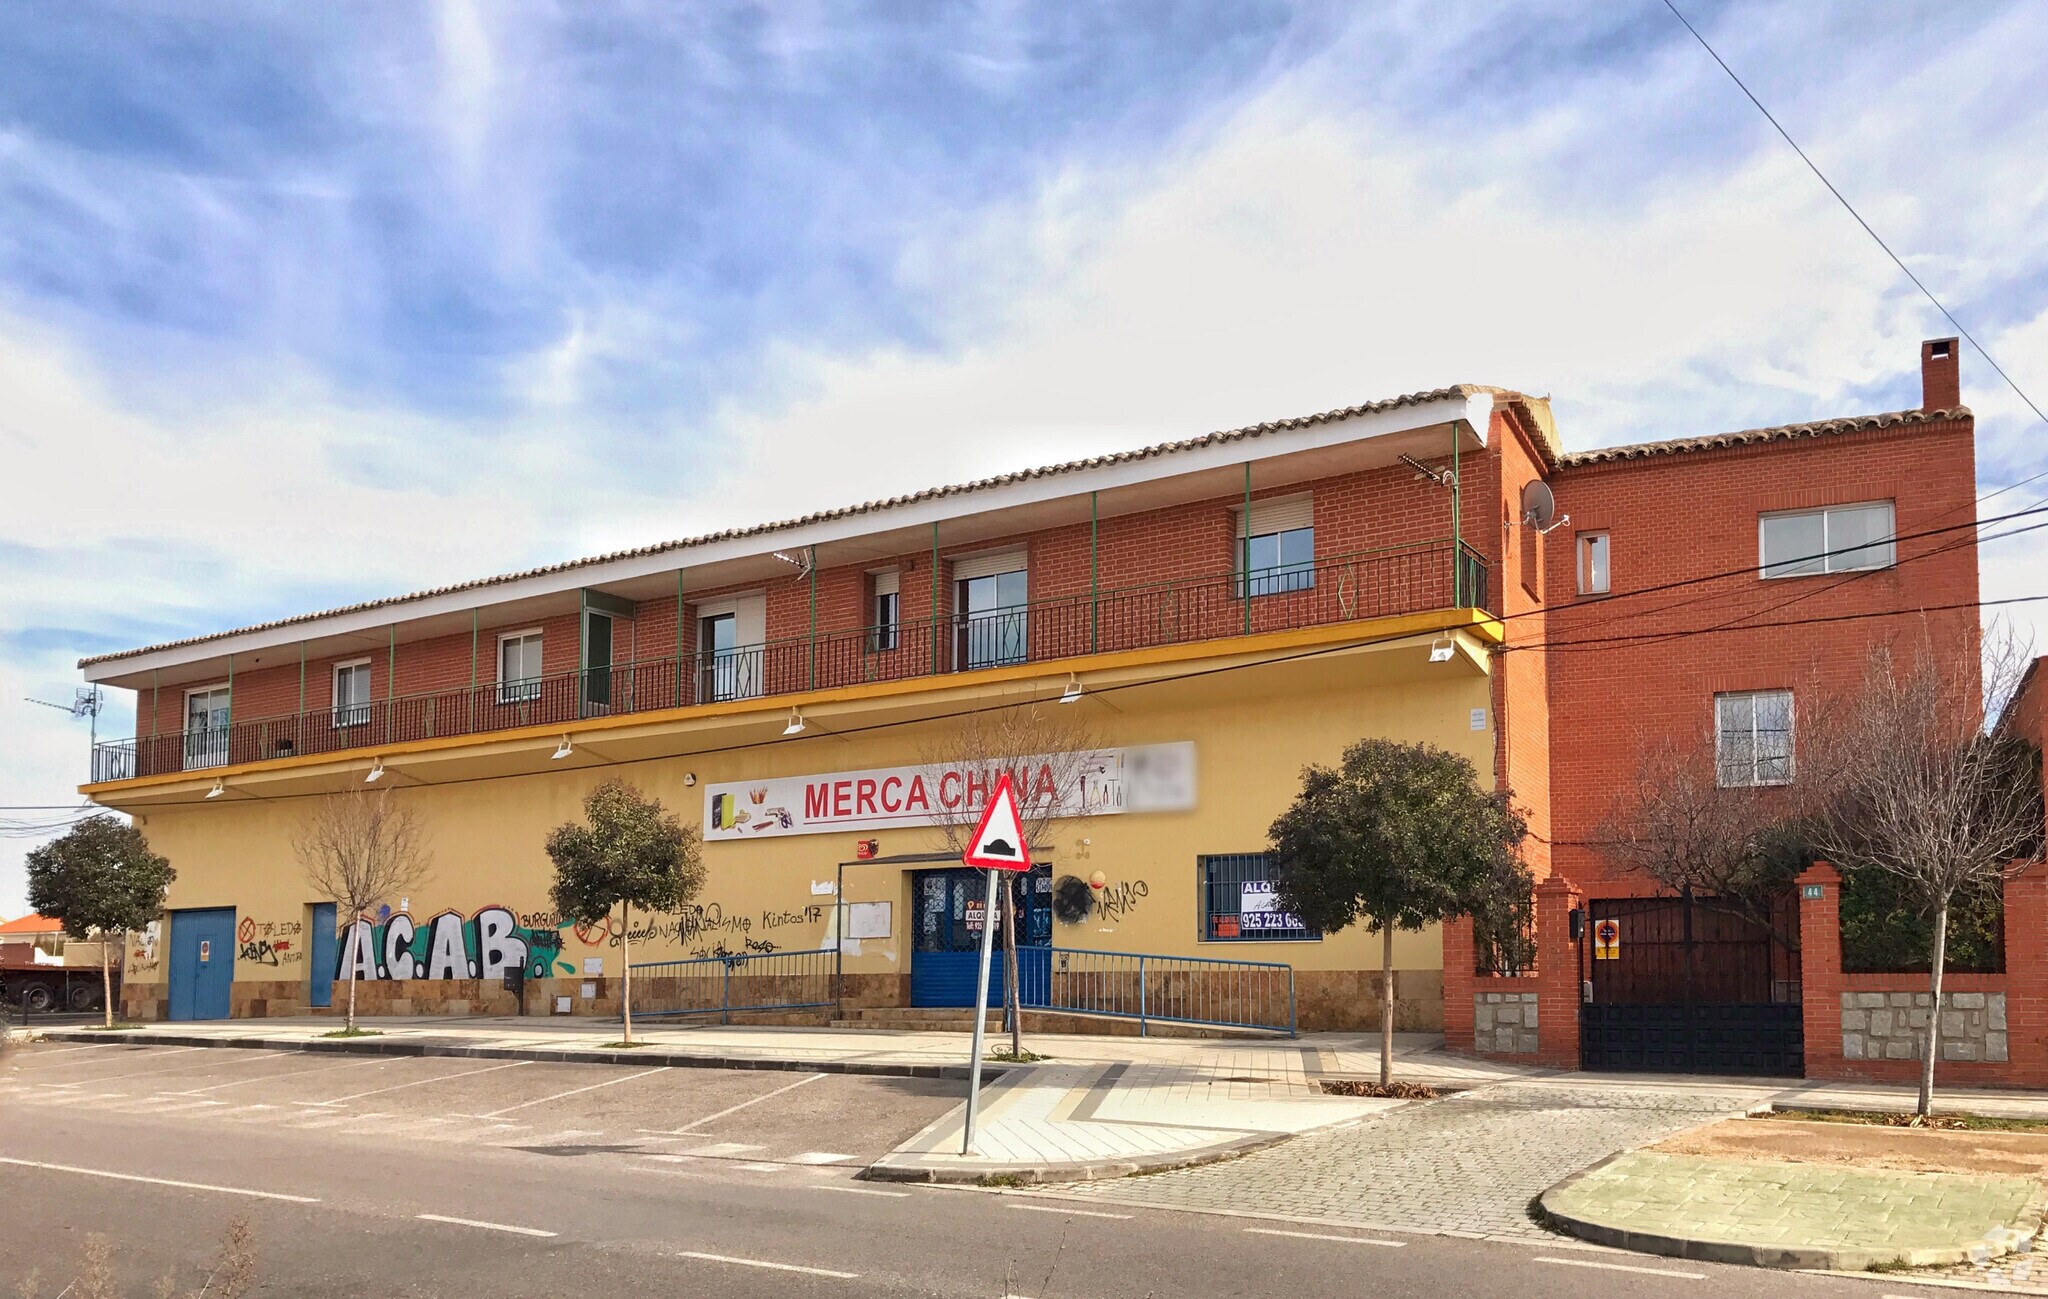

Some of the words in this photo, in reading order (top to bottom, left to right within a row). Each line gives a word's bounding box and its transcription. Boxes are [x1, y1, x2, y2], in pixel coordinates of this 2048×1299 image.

[804, 773, 930, 819] MERCA
[1807, 887, 1819, 896] 44
[968, 911, 998, 919] ALQUA
[1242, 913, 1262, 928] 925
[1264, 913, 1283, 928] 223
